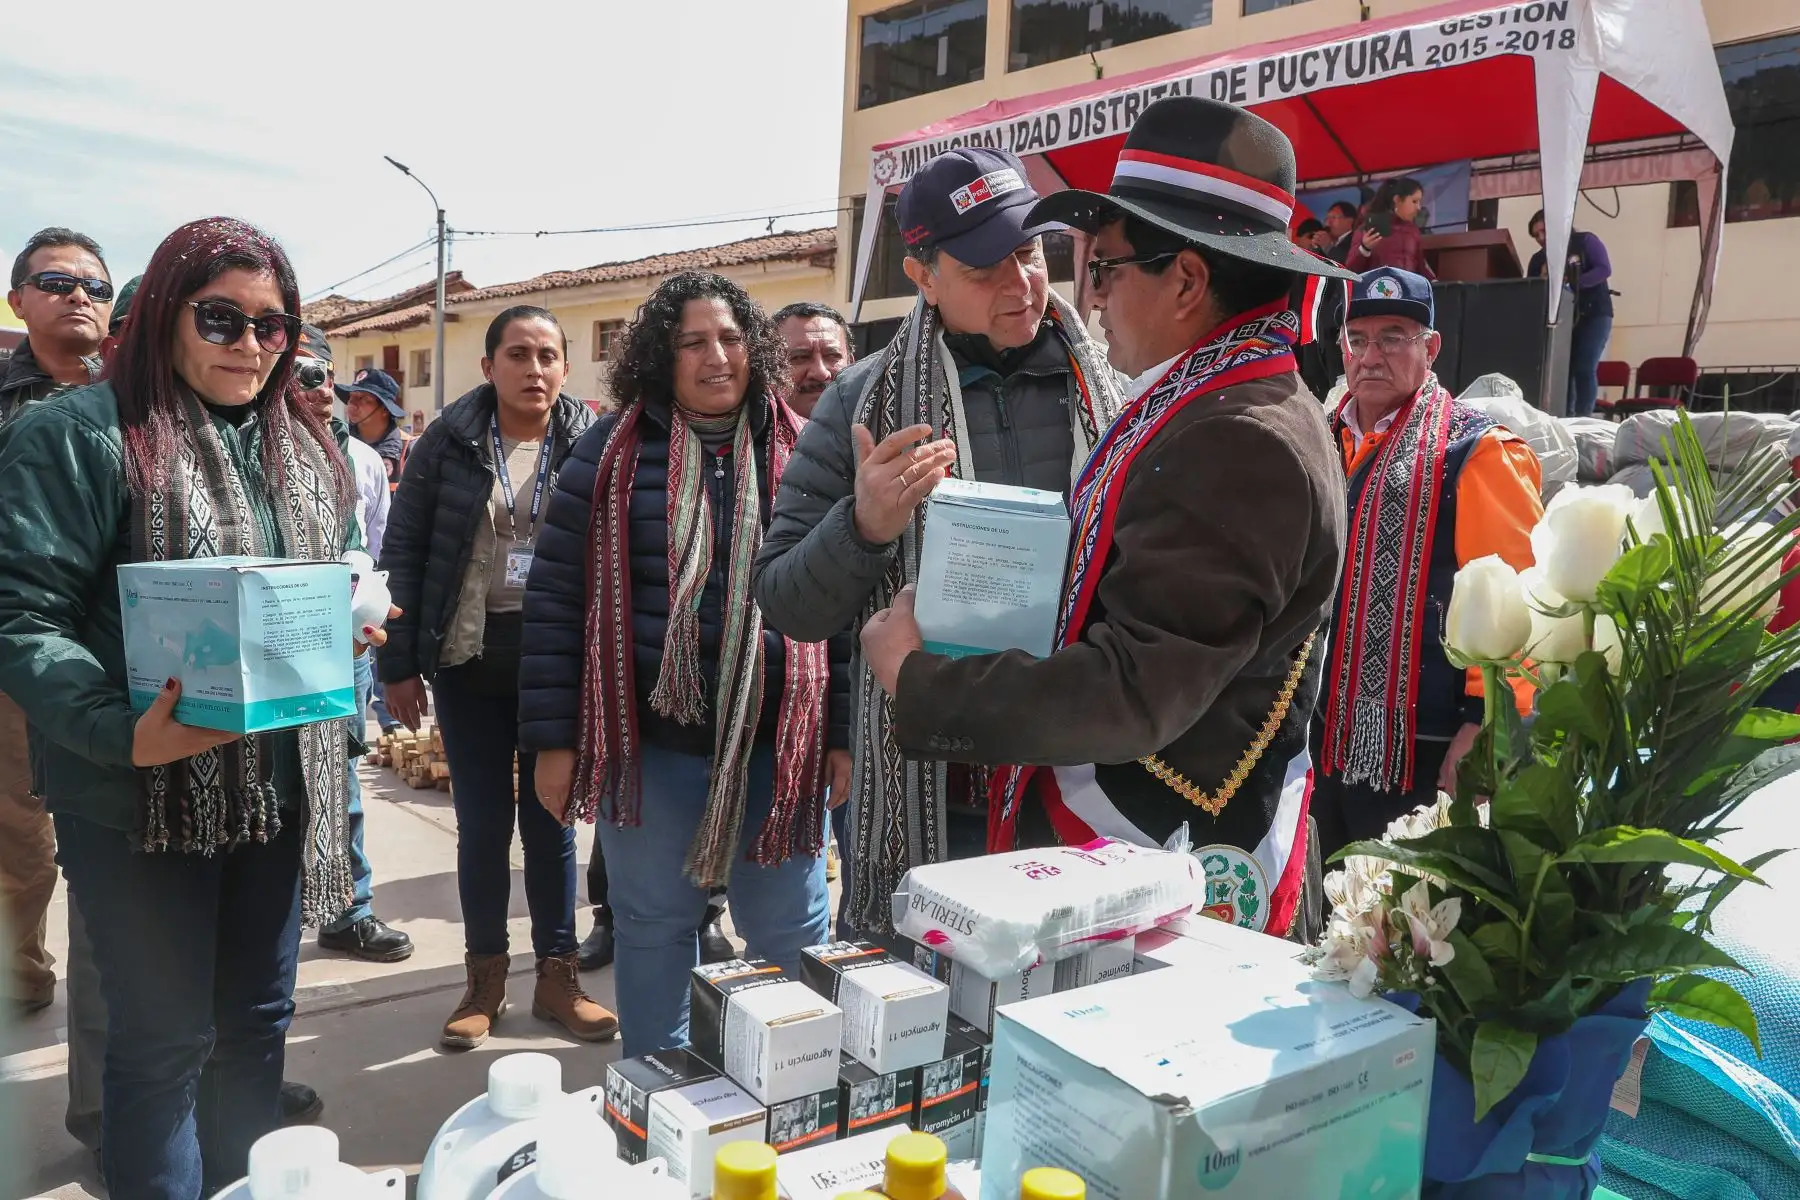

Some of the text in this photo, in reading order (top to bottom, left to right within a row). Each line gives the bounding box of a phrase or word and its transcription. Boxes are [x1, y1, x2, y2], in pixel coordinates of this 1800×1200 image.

[1425, 36, 1488, 66] 2015
[1210, 66, 1248, 103] DE
[1258, 30, 1414, 98] PUCYURA
[971, 186, 989, 199] PERÚ
[951, 522, 990, 532] INSTRUCCIONES
[918, 883, 982, 920] laboratorio
[911, 893, 976, 936] STERILAB
[1097, 962, 1131, 981] Bovimec
[889, 1021, 941, 1042] Agromycin 11
[774, 1061, 784, 1072] 11
[787, 1047, 834, 1067] Agromycin
[923, 1109, 971, 1133] Agromycin 11
[1202, 1147, 1241, 1175] 10ml
